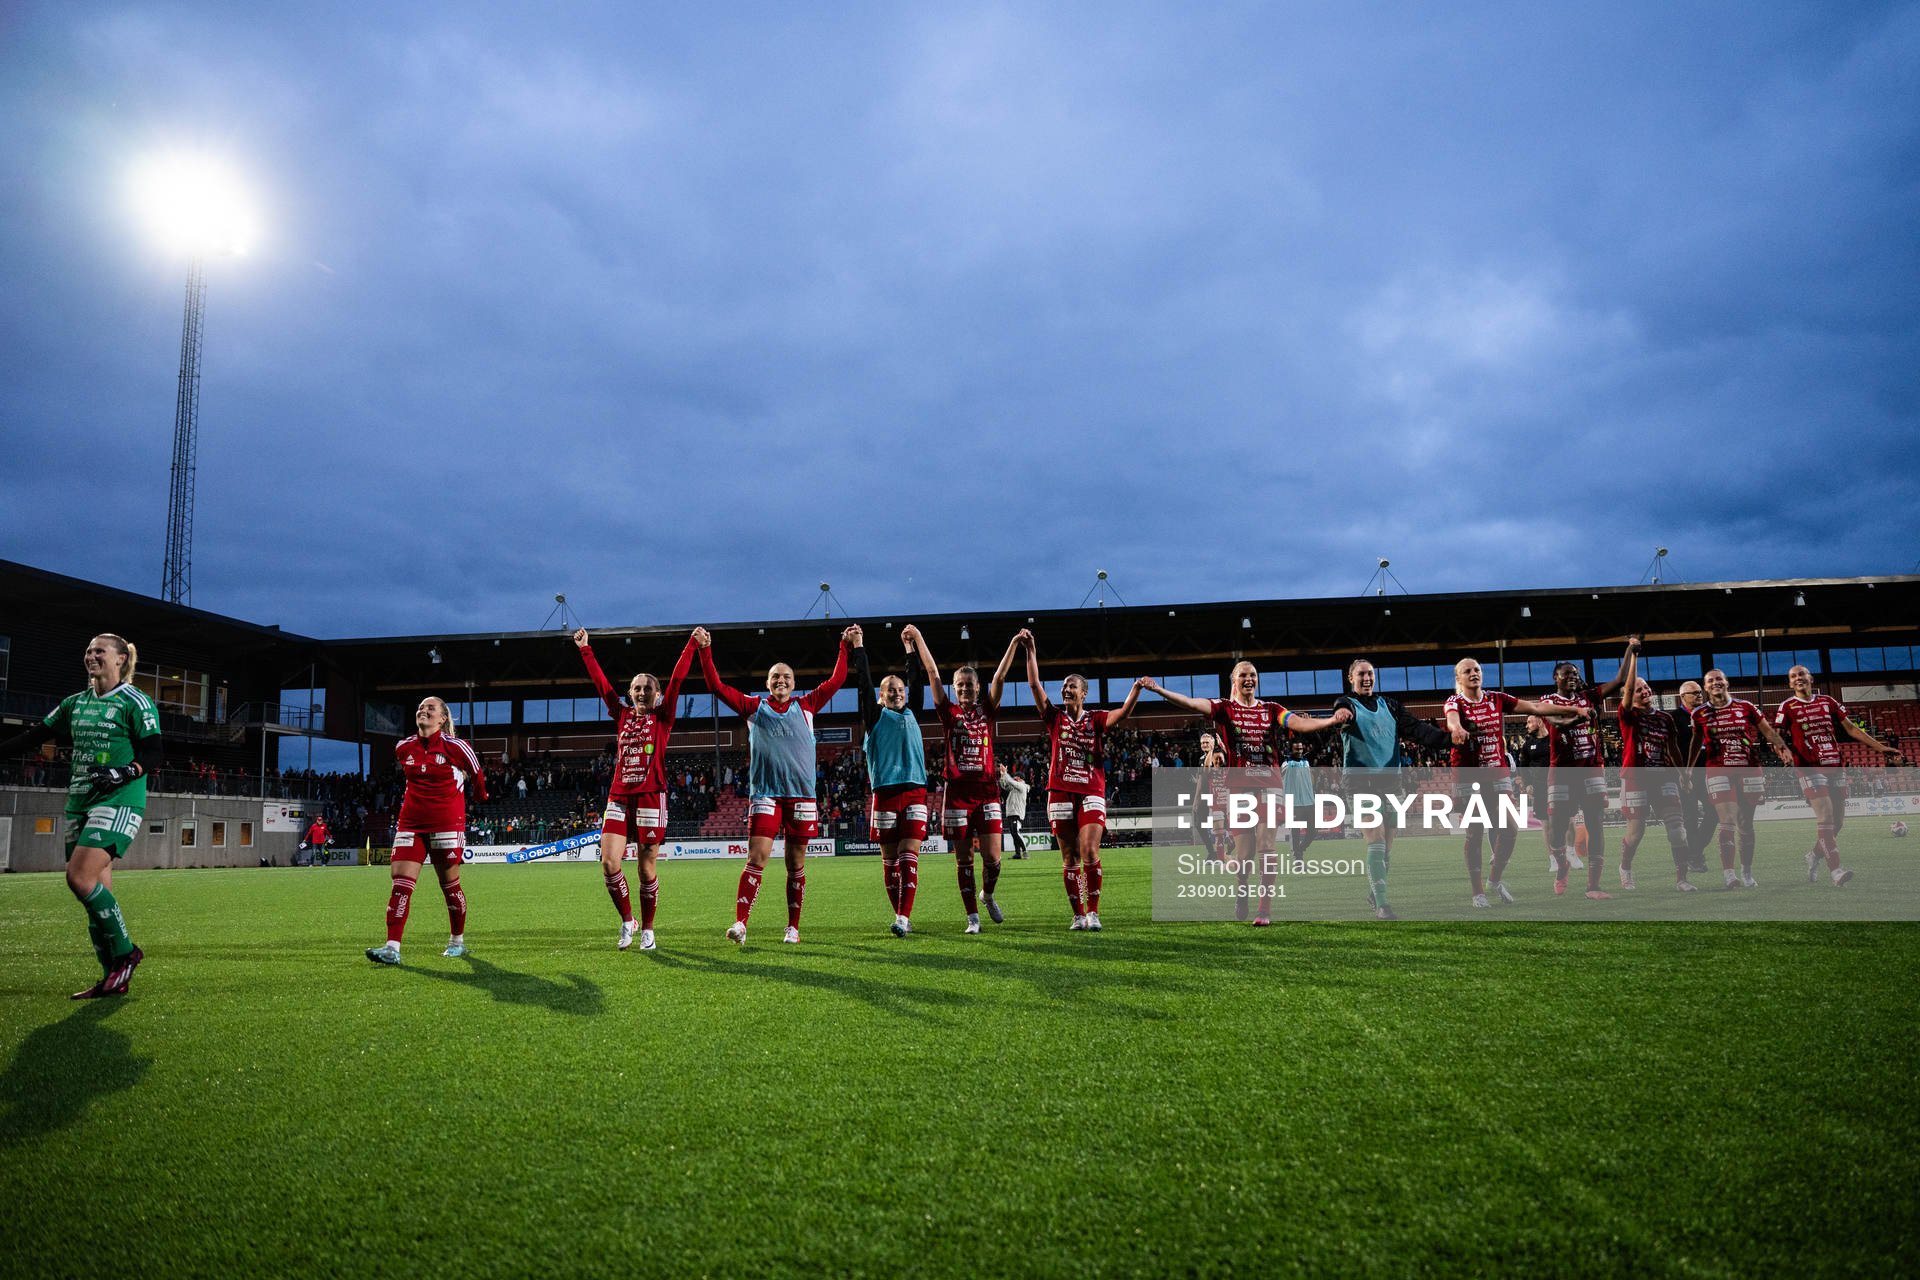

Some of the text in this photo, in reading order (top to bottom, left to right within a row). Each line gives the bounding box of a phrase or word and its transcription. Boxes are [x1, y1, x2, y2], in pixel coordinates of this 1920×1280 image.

[579, 833, 602, 845] OBO
[528, 845, 557, 858] OBOS
[684, 847, 721, 855] LINDBÄCKS
[728, 845, 748, 854] PA's
